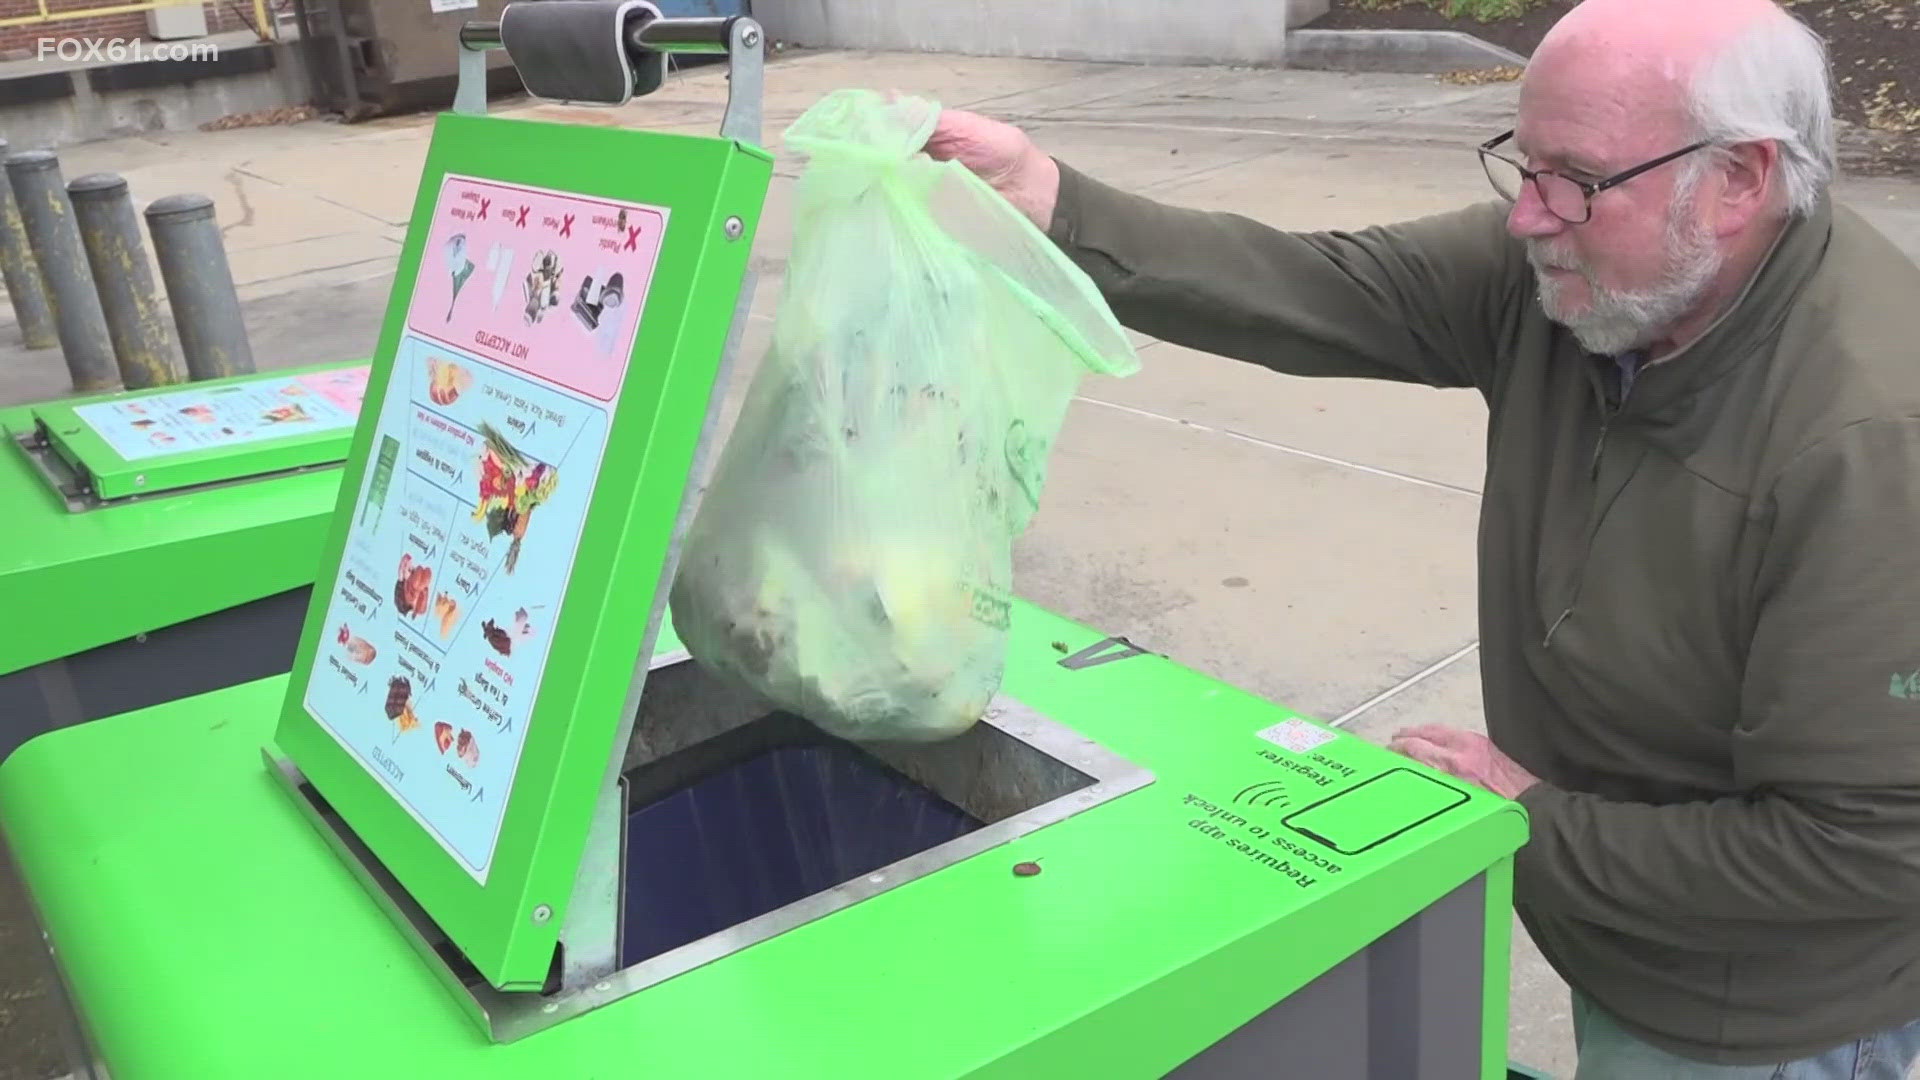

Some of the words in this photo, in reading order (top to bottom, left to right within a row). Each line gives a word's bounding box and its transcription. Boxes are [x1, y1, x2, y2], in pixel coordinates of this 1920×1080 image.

[541, 216, 560, 229] Metal
[597, 238, 621, 253] Plastic
[474, 329, 511, 353] ACCEPTED
[510, 342, 529, 359] NOT
[505, 415, 526, 434] Grains
[454, 572, 471, 593] Dairy
[473, 670, 490, 692] Bags
[502, 671, 513, 686] NO
[488, 684, 500, 701] Tea
[481, 702, 502, 727] Coffee
[371, 743, 405, 784] ACCEPTED
[1256, 750, 1334, 786] Register
[1307, 753, 1357, 777] here:
[1183, 794, 1247, 827] unlock
[1188, 819, 1226, 839] app
[1249, 826, 1270, 839] to
[1226, 838, 1317, 888] Requires
[1272, 837, 1342, 874] access
